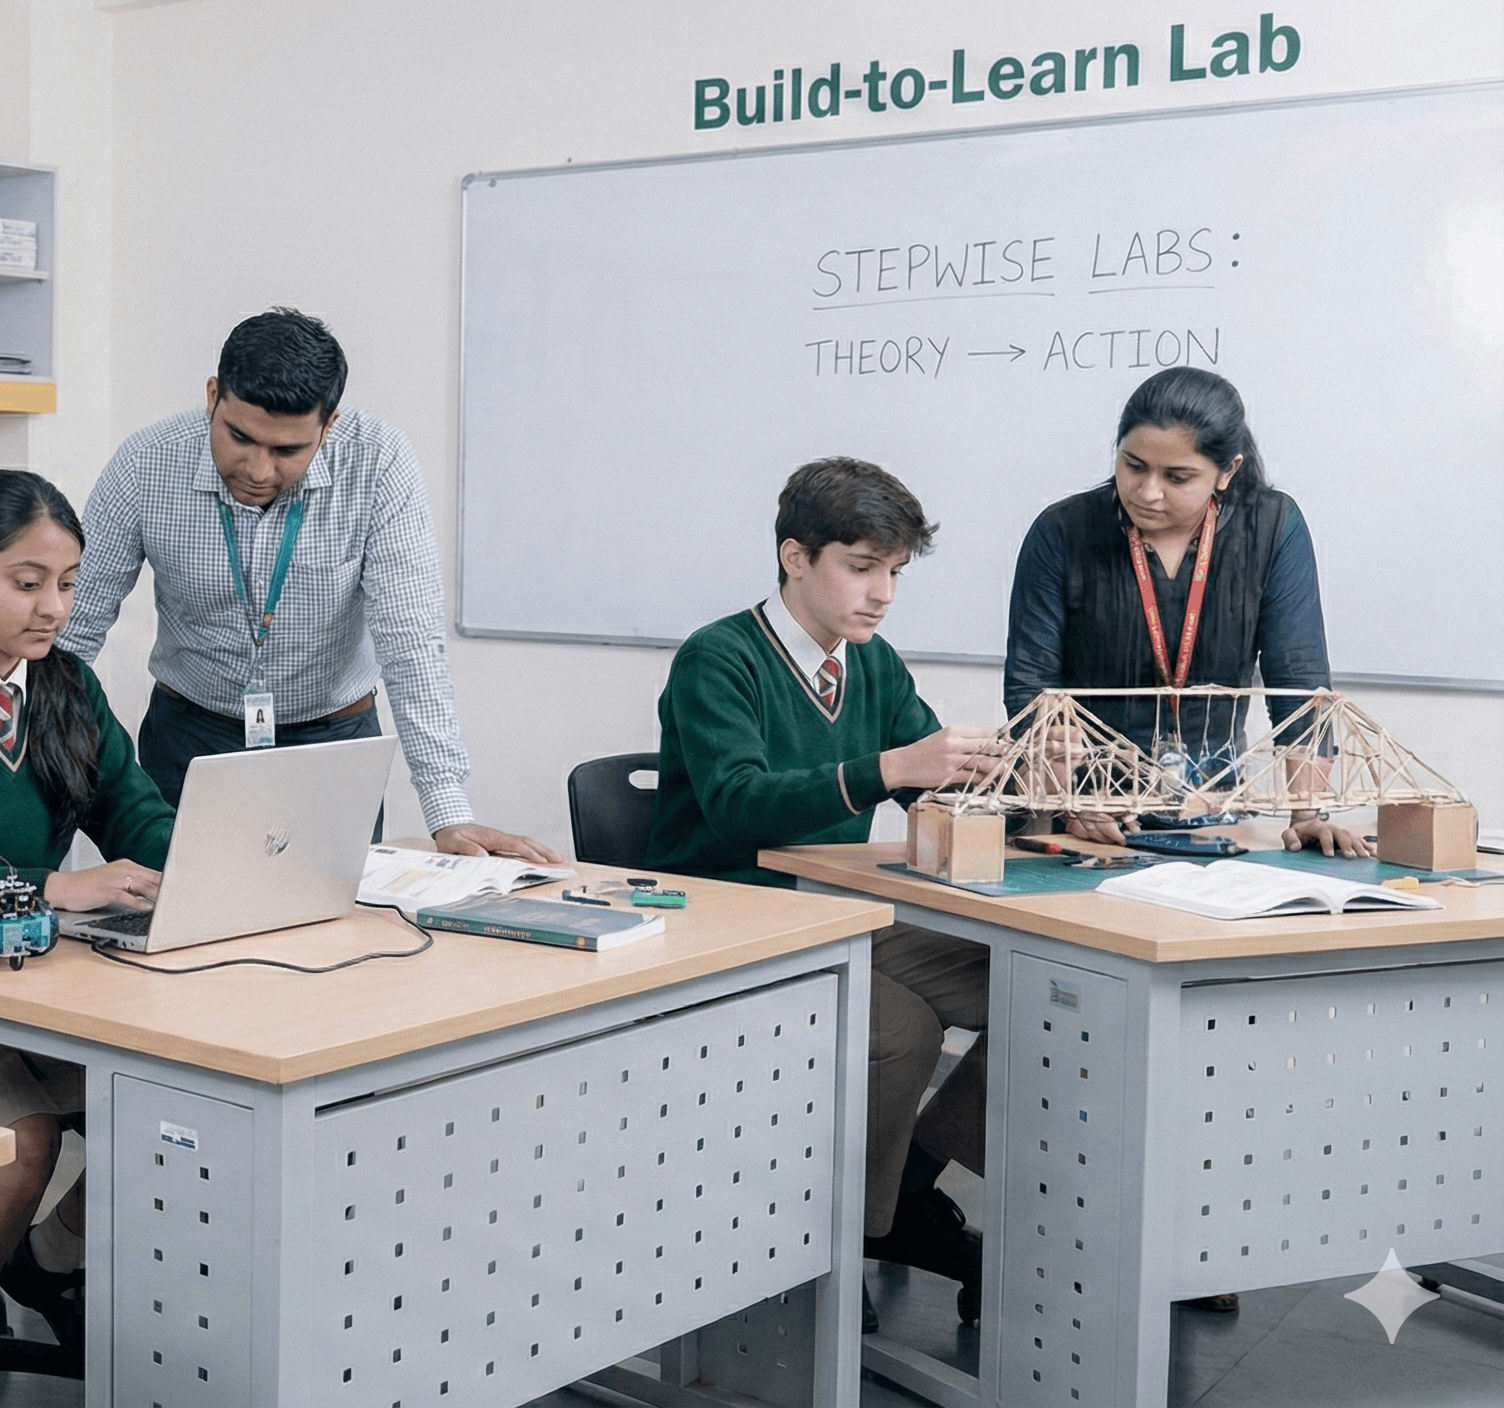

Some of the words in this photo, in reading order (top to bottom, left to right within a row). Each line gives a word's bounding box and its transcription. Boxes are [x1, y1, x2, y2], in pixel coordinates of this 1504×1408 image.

[695, 44, 1139, 131] Build-to-Learn
[1170, 13, 1300, 82] Lab
[813, 238, 1054, 297] STEPWISE
[1092, 228, 1240, 278] LABS:
[805, 336, 949, 378] THEORY
[1044, 328, 1221, 370] ACTION
